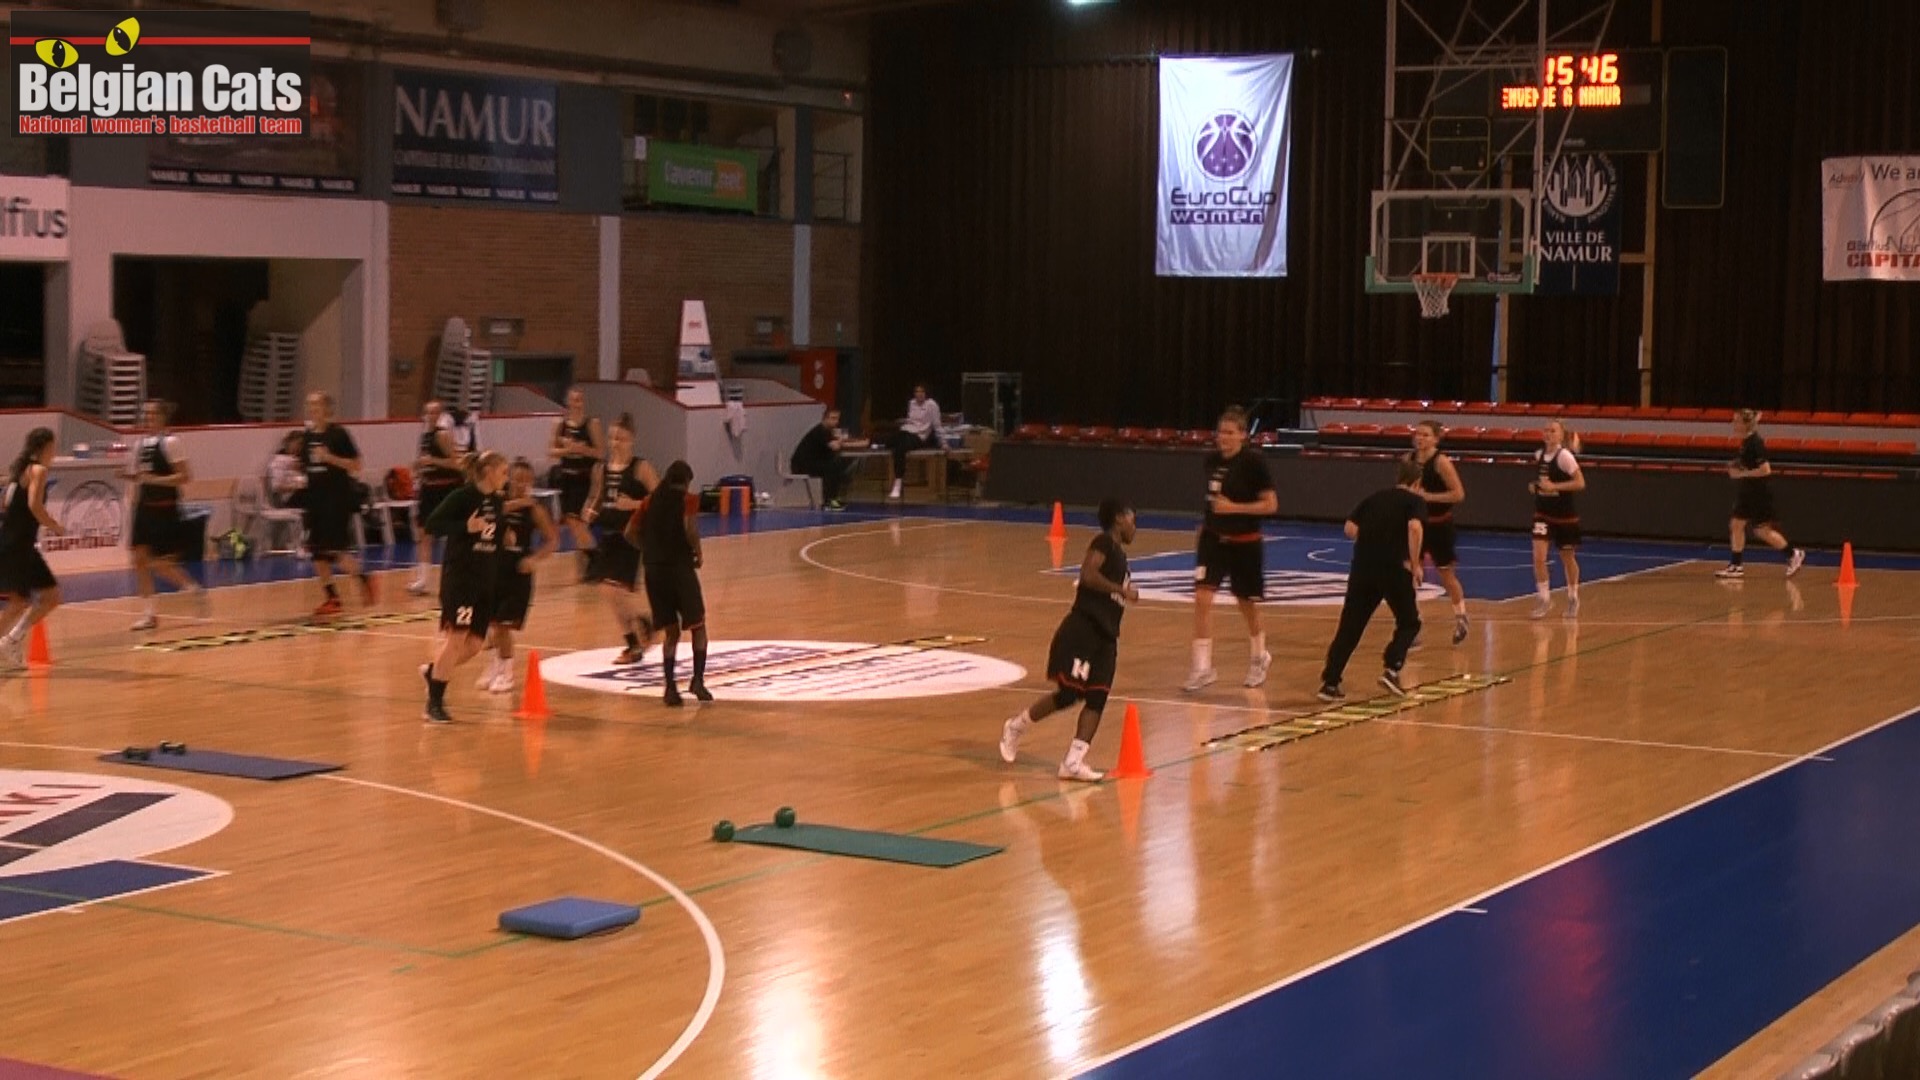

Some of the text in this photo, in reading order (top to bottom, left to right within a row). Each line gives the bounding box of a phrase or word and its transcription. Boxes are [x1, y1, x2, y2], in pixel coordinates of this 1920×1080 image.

[1579, 84, 1621, 106] NAMUR
[395, 85, 556, 147] NAMUR
[1871, 163, 1900, 181] We
[1171, 186, 1277, 205] EuroCup
[1172, 209, 1264, 224] women
[1546, 231, 1606, 244] VILLE DE
[1540, 245, 1613, 262] NAMUR
